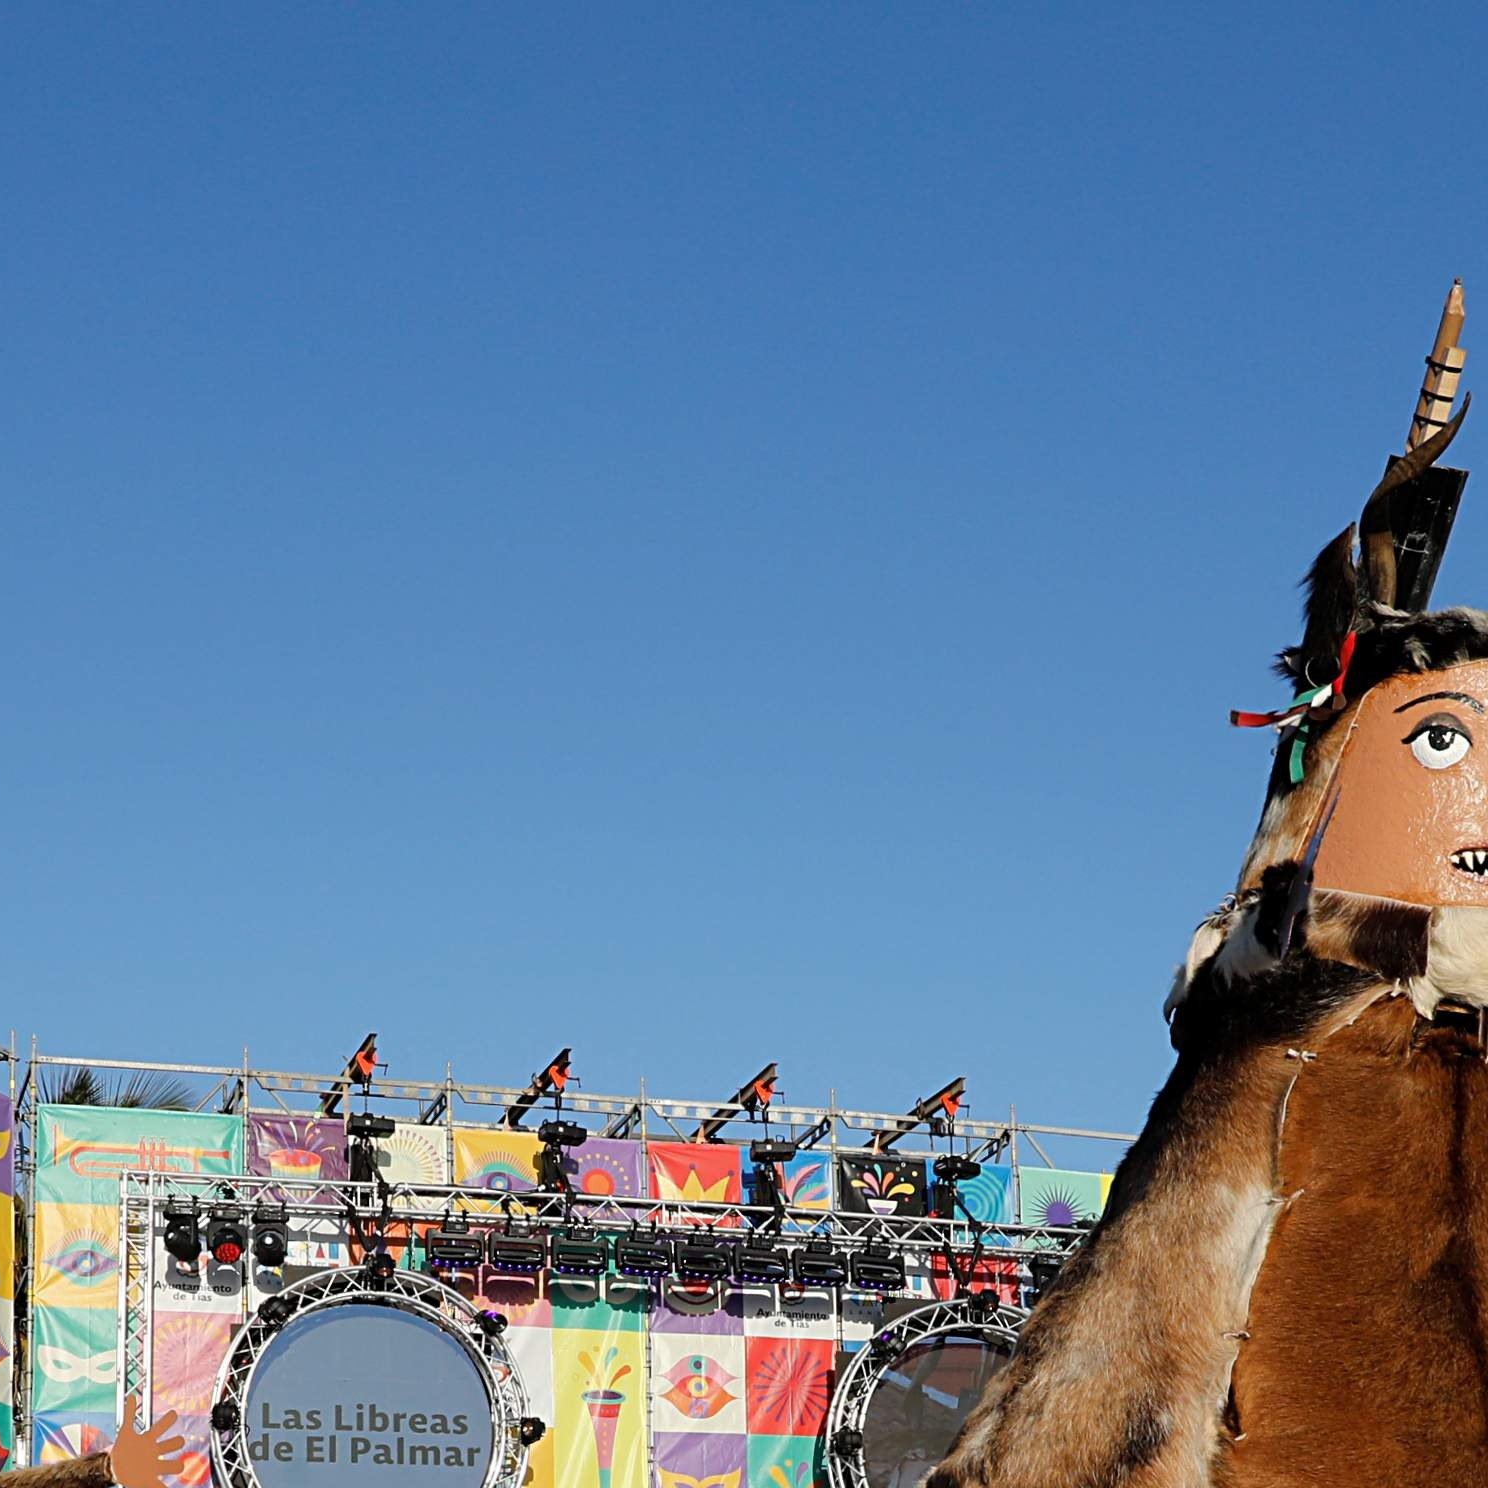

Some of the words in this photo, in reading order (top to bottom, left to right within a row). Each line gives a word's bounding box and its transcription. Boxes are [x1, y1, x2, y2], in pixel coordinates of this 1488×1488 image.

[173, 1292, 186, 1301] de
[774, 1319, 786, 1327] de
[262, 1402, 322, 1430] Las
[335, 1403, 469, 1435] Libreas
[249, 1433, 293, 1462] de
[306, 1435, 336, 1463] El
[351, 1437, 481, 1467] Palmar
